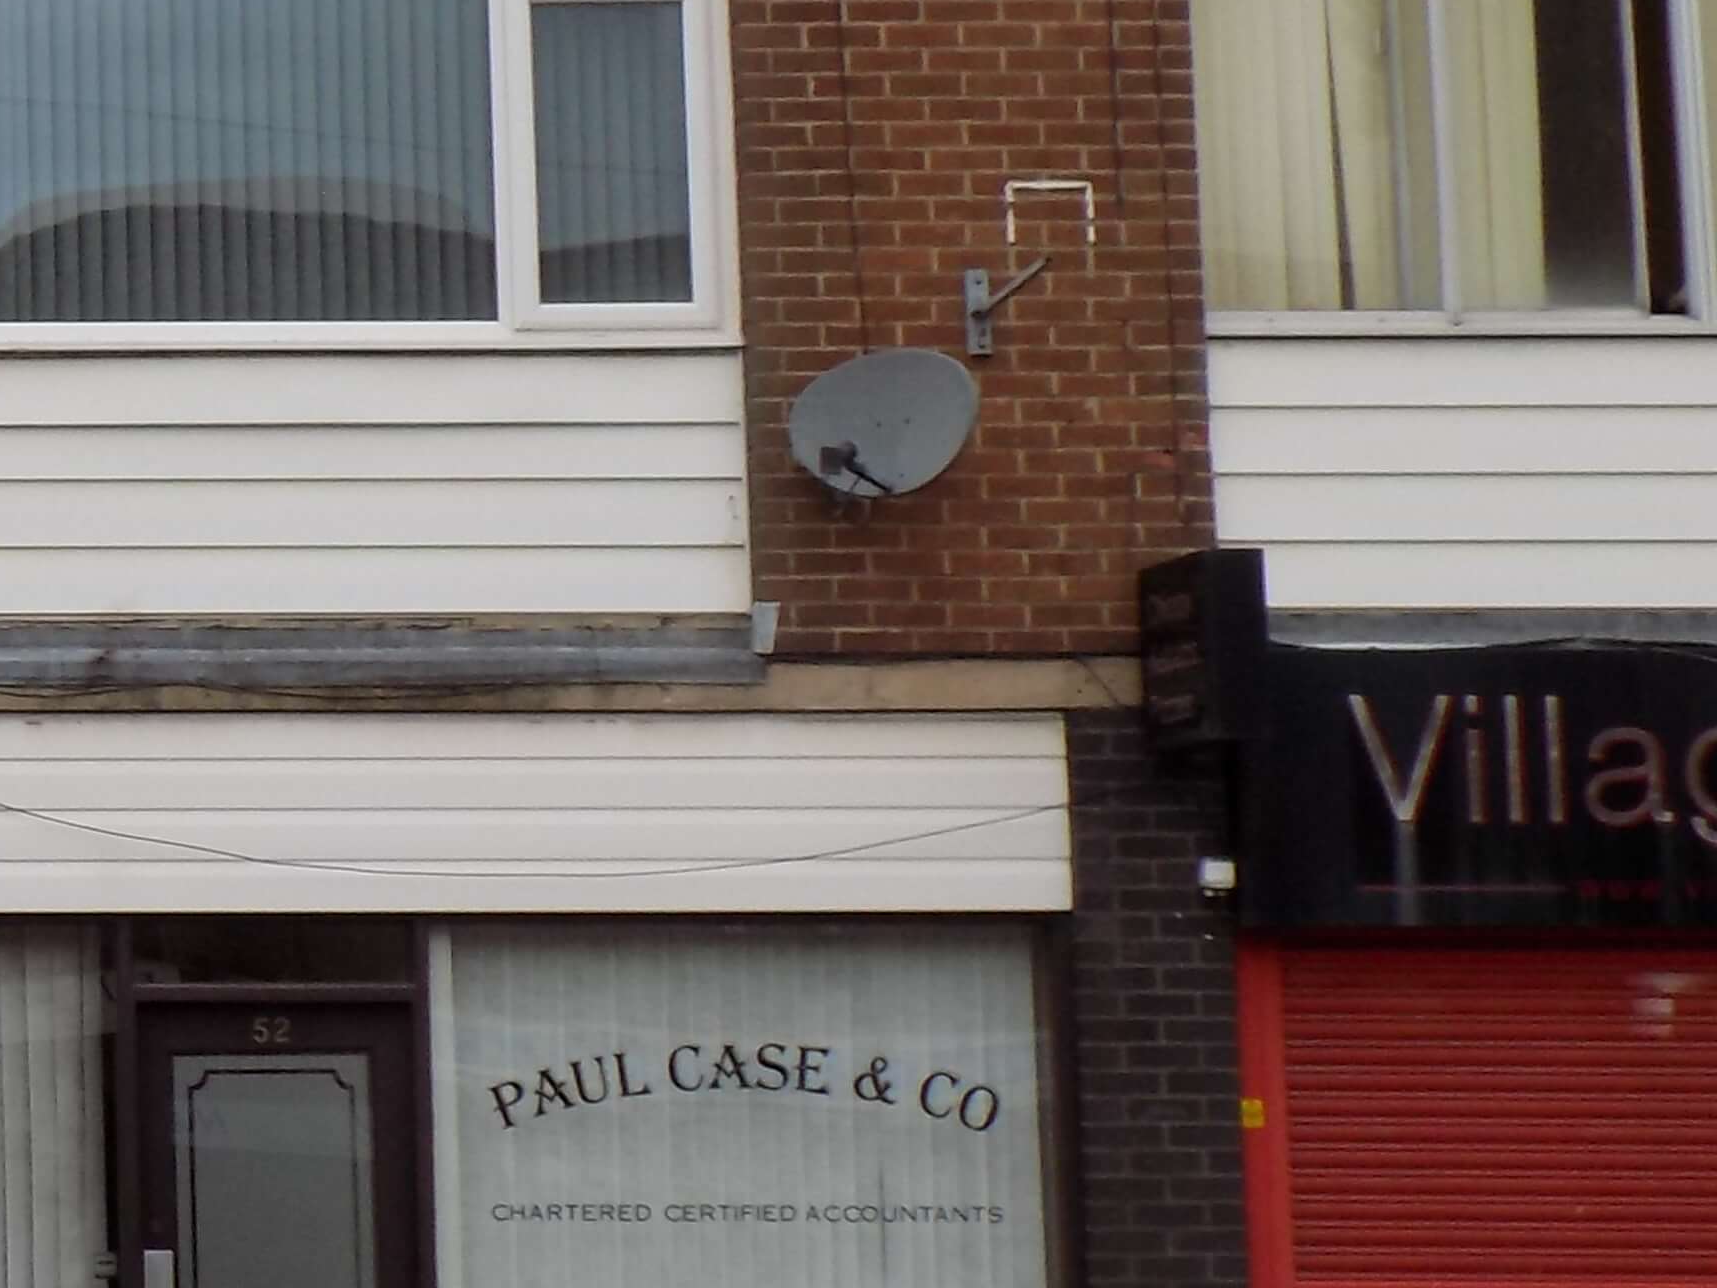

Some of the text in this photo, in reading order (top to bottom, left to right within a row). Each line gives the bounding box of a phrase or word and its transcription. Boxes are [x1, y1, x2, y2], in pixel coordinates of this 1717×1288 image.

[252, 1017, 291, 1043] 52
[489, 1043, 1000, 1132] PAUL CASE & CO
[491, 1202, 1004, 1225] CHARTERED CERTIFIED ACCOUNTANTS
